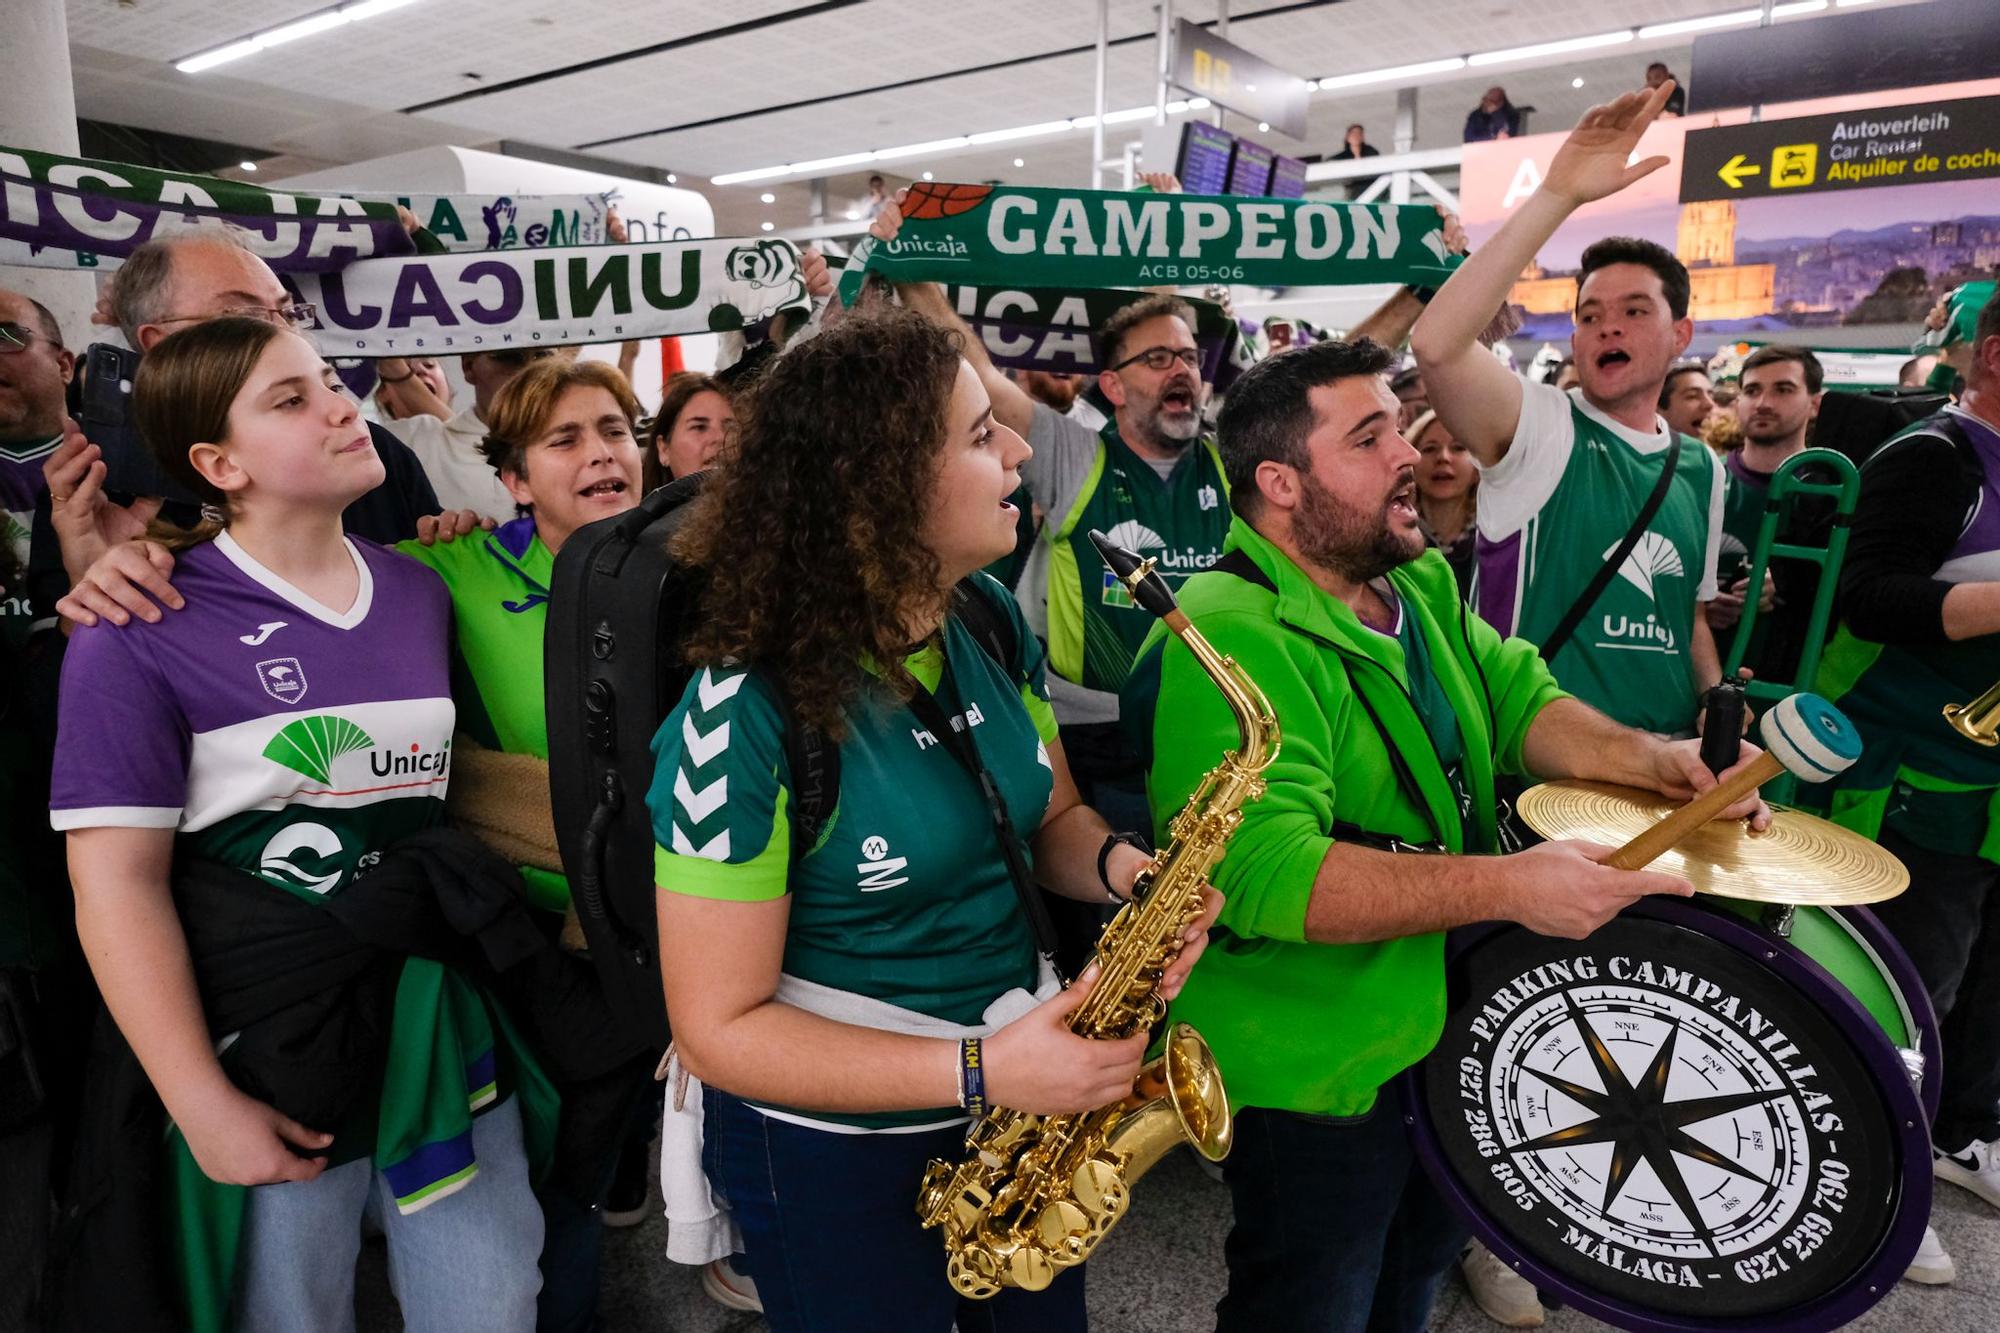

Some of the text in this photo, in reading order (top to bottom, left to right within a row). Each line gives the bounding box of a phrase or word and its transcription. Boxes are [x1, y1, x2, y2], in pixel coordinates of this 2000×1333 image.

[1831, 112, 1950, 141] Autoverleih
[1830, 136, 1923, 161] Car Rental
[1826, 155, 1907, 183] Alquiler
[1913, 154, 1940, 173] de
[987, 194, 1400, 260] CAMPEON
[886, 234, 968, 257] Unicaja
[1138, 264, 1245, 279] ACB 05-06
[1614, 1021, 1640, 1032] NNE
[1470, 956, 1844, 1133] PARKING CAMPANILLAS
[1543, 1035, 1563, 1055] NNW
[1701, 1053, 1726, 1075] ENE
[1459, 1056, 1541, 1211] 627 286 805
[1751, 1130, 1764, 1151] ESE
[1721, 1196, 1741, 1212] SSE
[1639, 1211, 1664, 1223] SSW
[1734, 1159, 1851, 1284] 627 239 790
[1560, 1225, 1703, 1288] MÁLAGA
